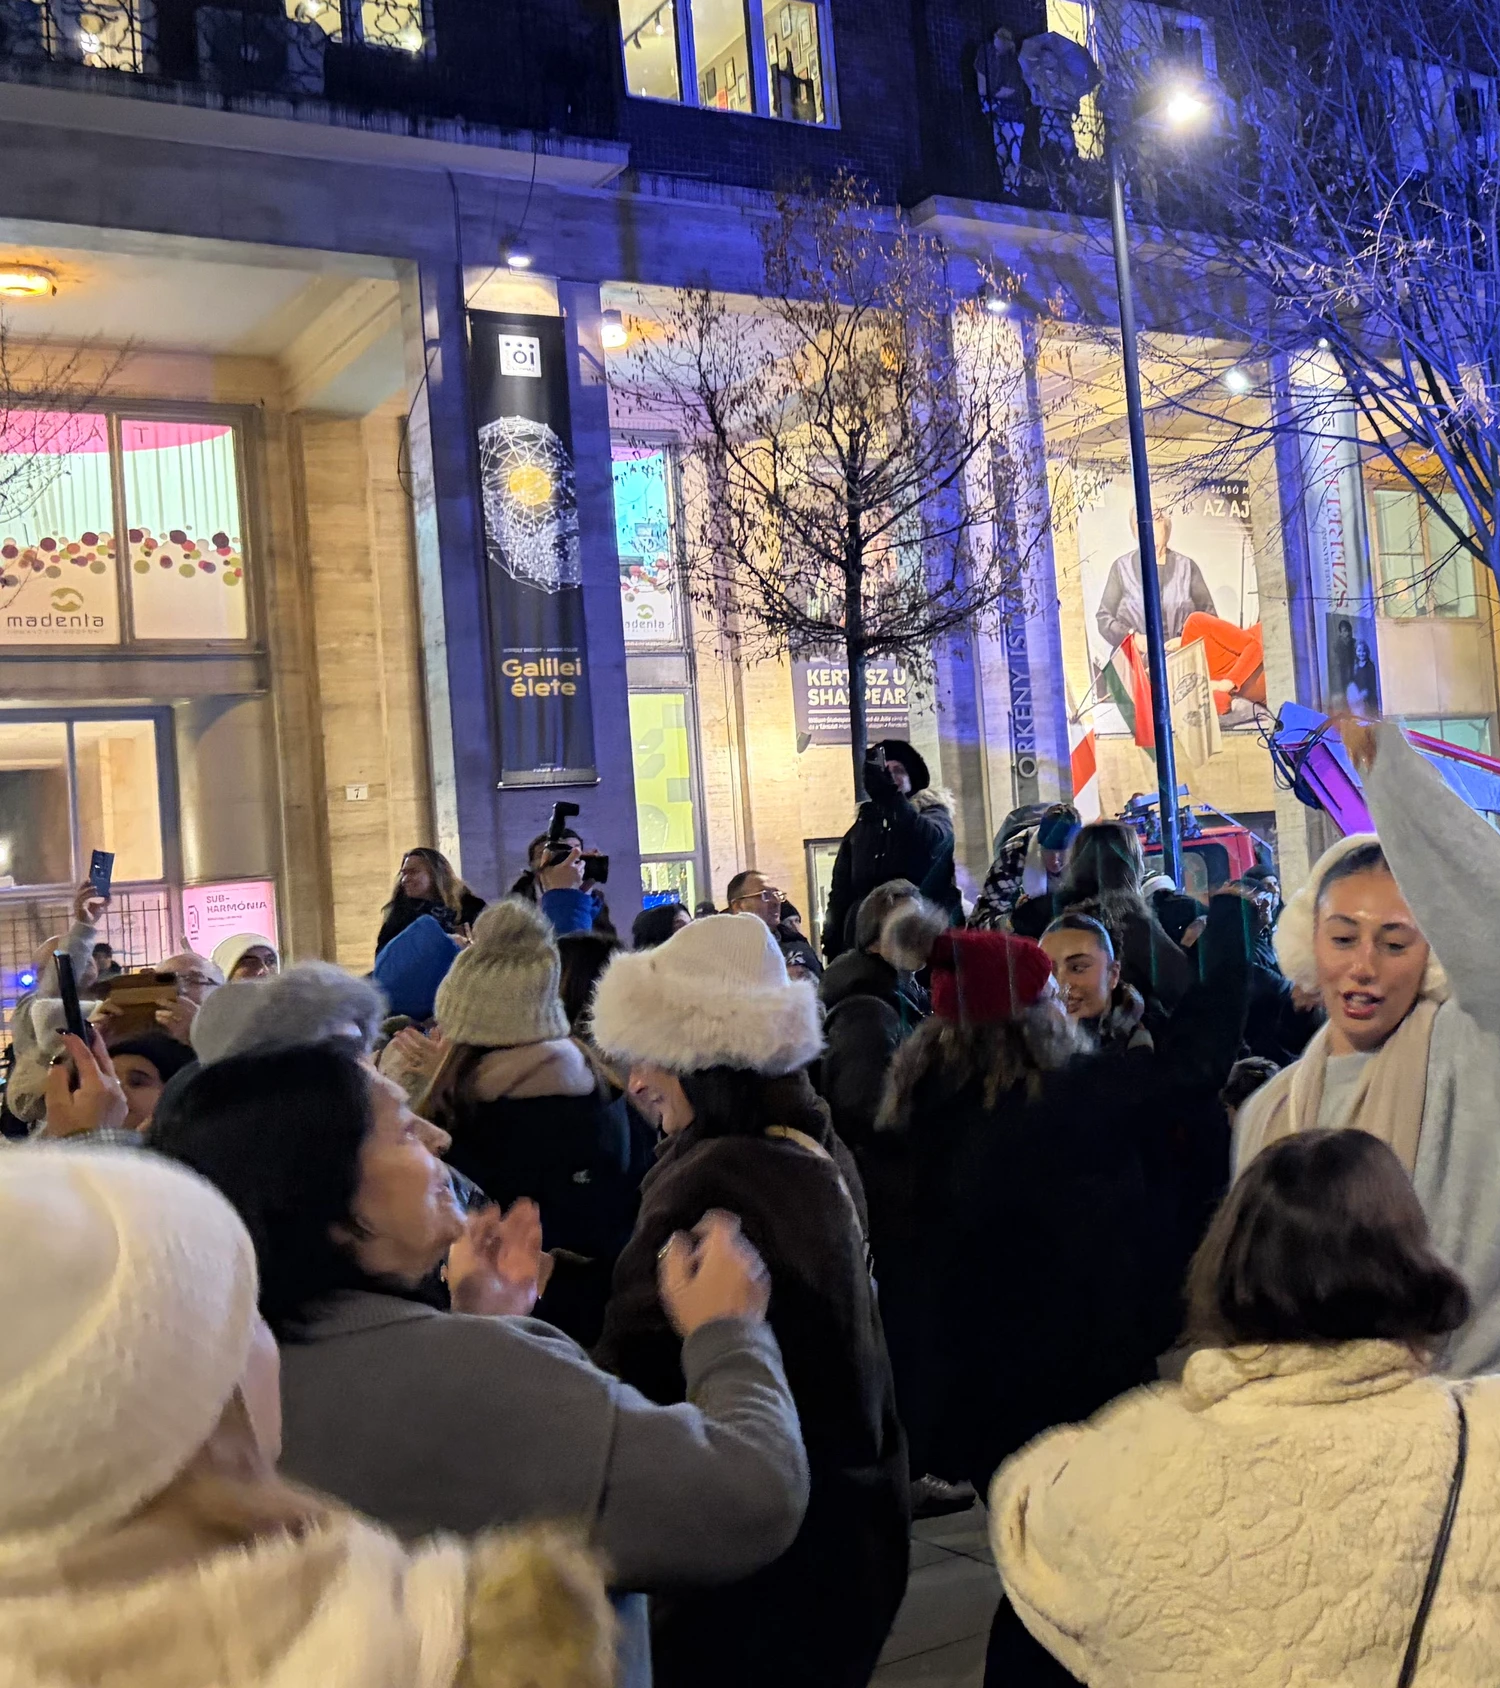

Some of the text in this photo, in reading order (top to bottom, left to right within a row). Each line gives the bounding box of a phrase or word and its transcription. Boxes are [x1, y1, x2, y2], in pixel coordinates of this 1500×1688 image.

[1203, 498, 1226, 517] AZ
[501, 657, 582, 677] Galilei
[806, 669, 889, 686] KERTSZ
[511, 677, 577, 697] élete
[206, 894, 230, 904] SUB-
[206, 901, 267, 914] HARMÓNIA
